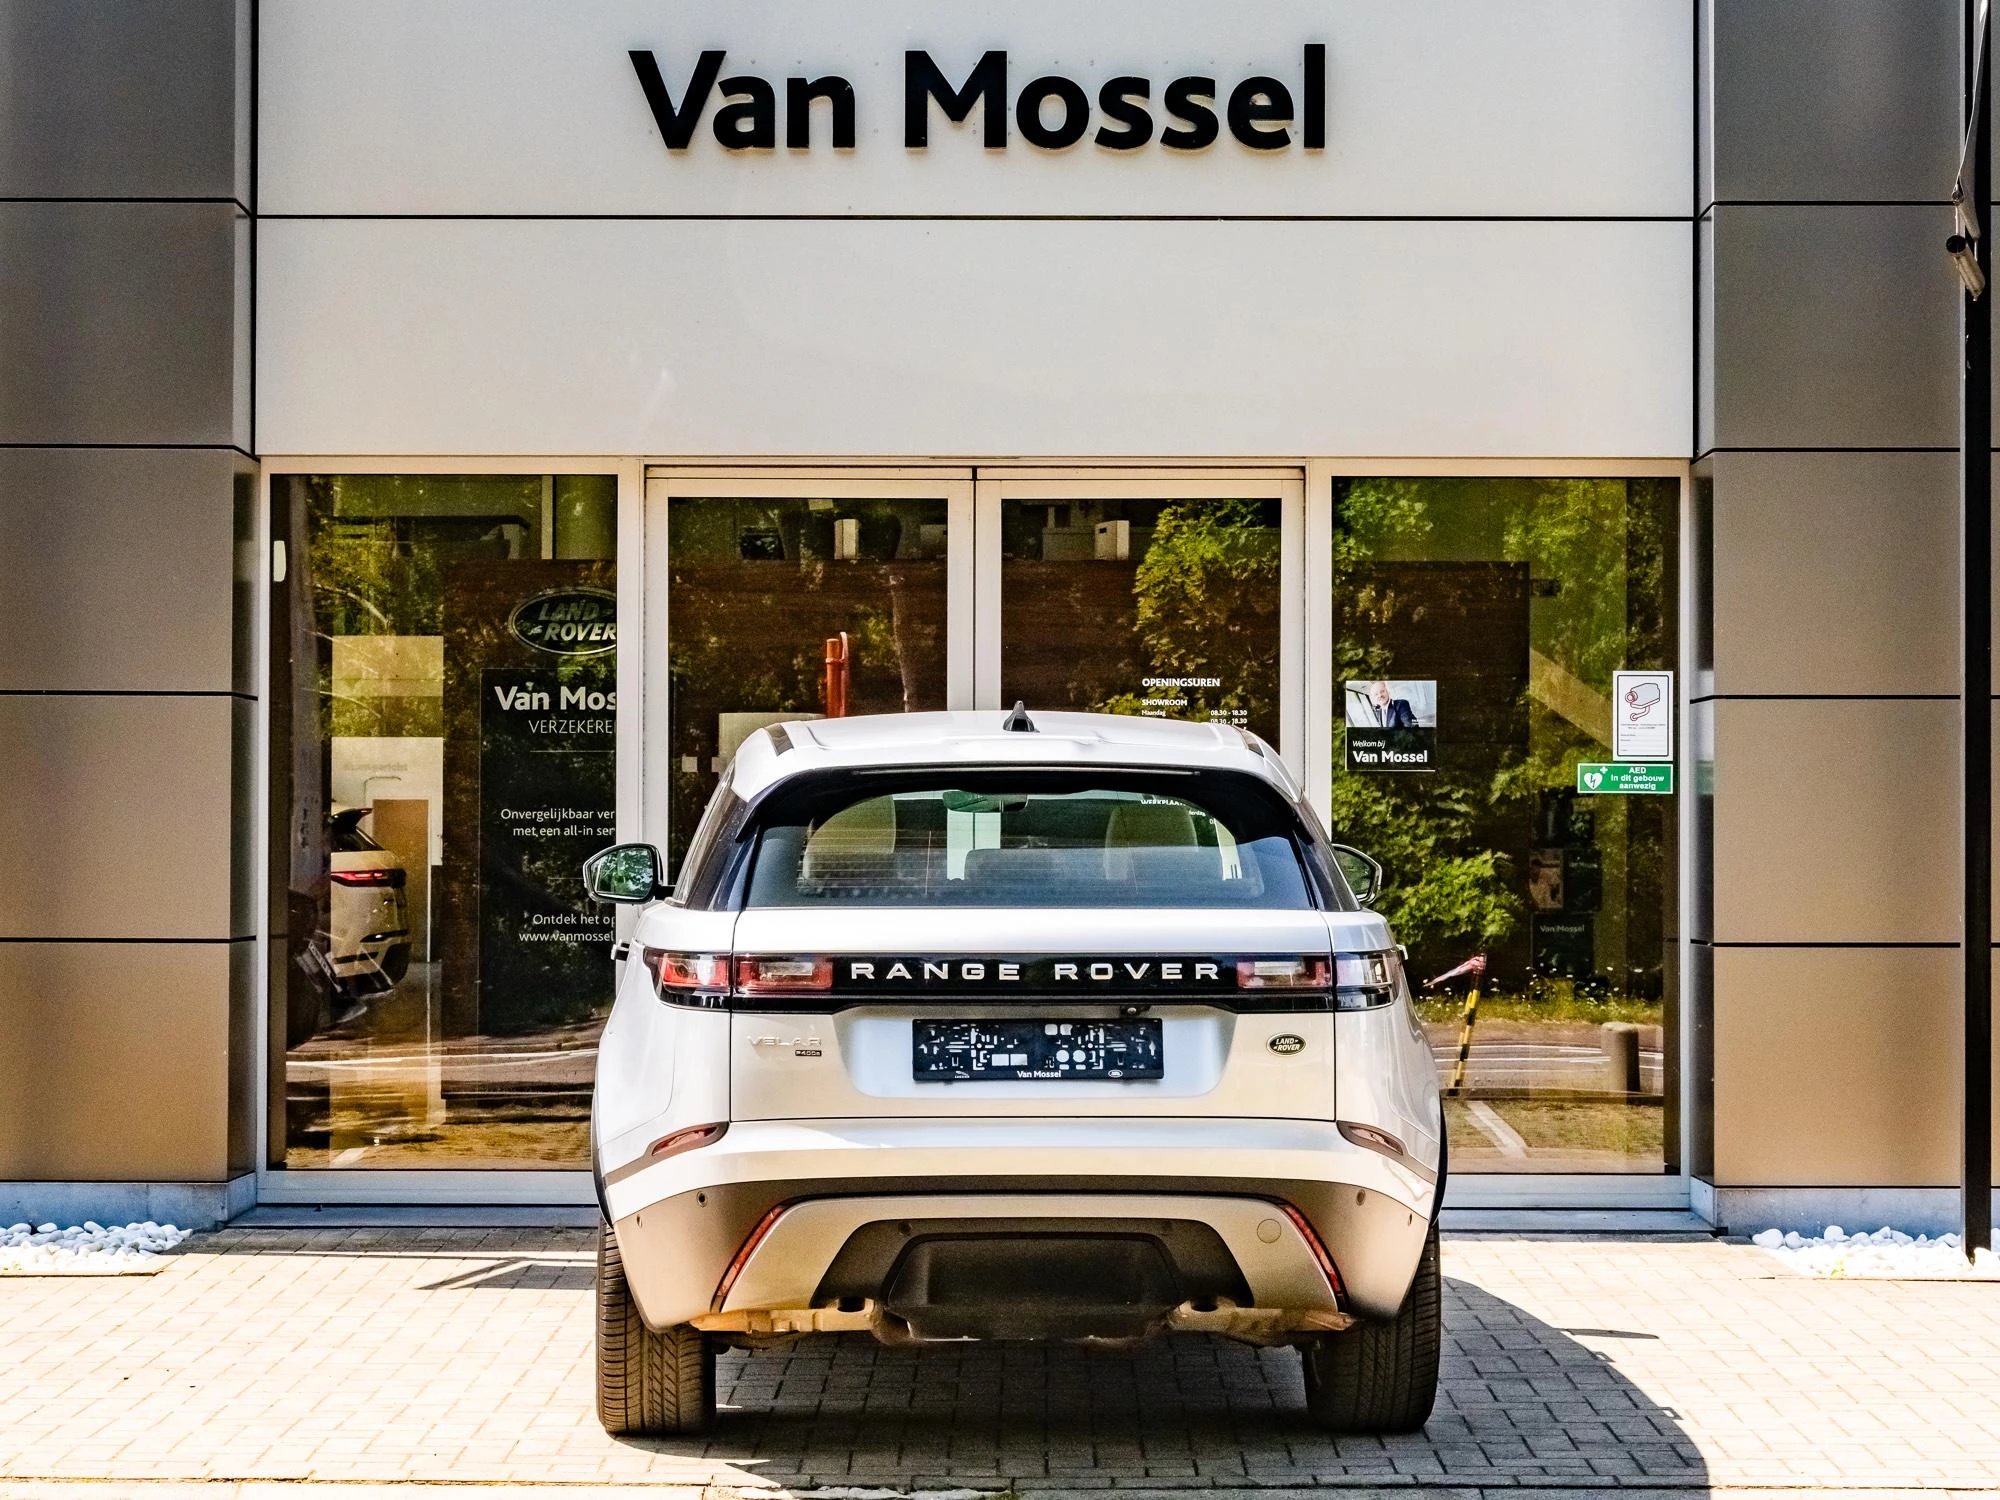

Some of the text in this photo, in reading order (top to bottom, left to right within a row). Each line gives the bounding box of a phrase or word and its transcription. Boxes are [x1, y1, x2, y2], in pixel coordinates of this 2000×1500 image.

[628, 43, 1326, 150] Van Mossel
[538, 603, 599, 621] LAND
[544, 622, 617, 641] ROVER
[1141, 677, 1220, 687] OPENINGSUREN
[494, 685, 550, 711] Van
[1141, 698, 1188, 706] SHOWROOM
[1141, 709, 1166, 717] Maandag
[528, 719, 617, 734] VERZEKERE
[1352, 740, 1386, 749] Welkom bij
[1352, 749, 1428, 763] Van Mossel
[1629, 766, 1647, 774] AED
[1620, 773, 1632, 781] dit
[1633, 774, 1665, 783] gebouw
[1619, 782, 1656, 790] aanwezig
[500, 808, 594, 822] Onvergelijkbaar
[540, 827, 561, 836] een
[563, 825, 593, 836] all-in
[533, 914, 577, 925] Ontdek
[580, 914, 600, 925] het
[850, 962, 1220, 981] RANGE ROVER
[1275, 1037, 1295, 1045] LAND
[1277, 1043, 1301, 1051] ROVER
[1016, 1069, 1062, 1078] Van Mossel
